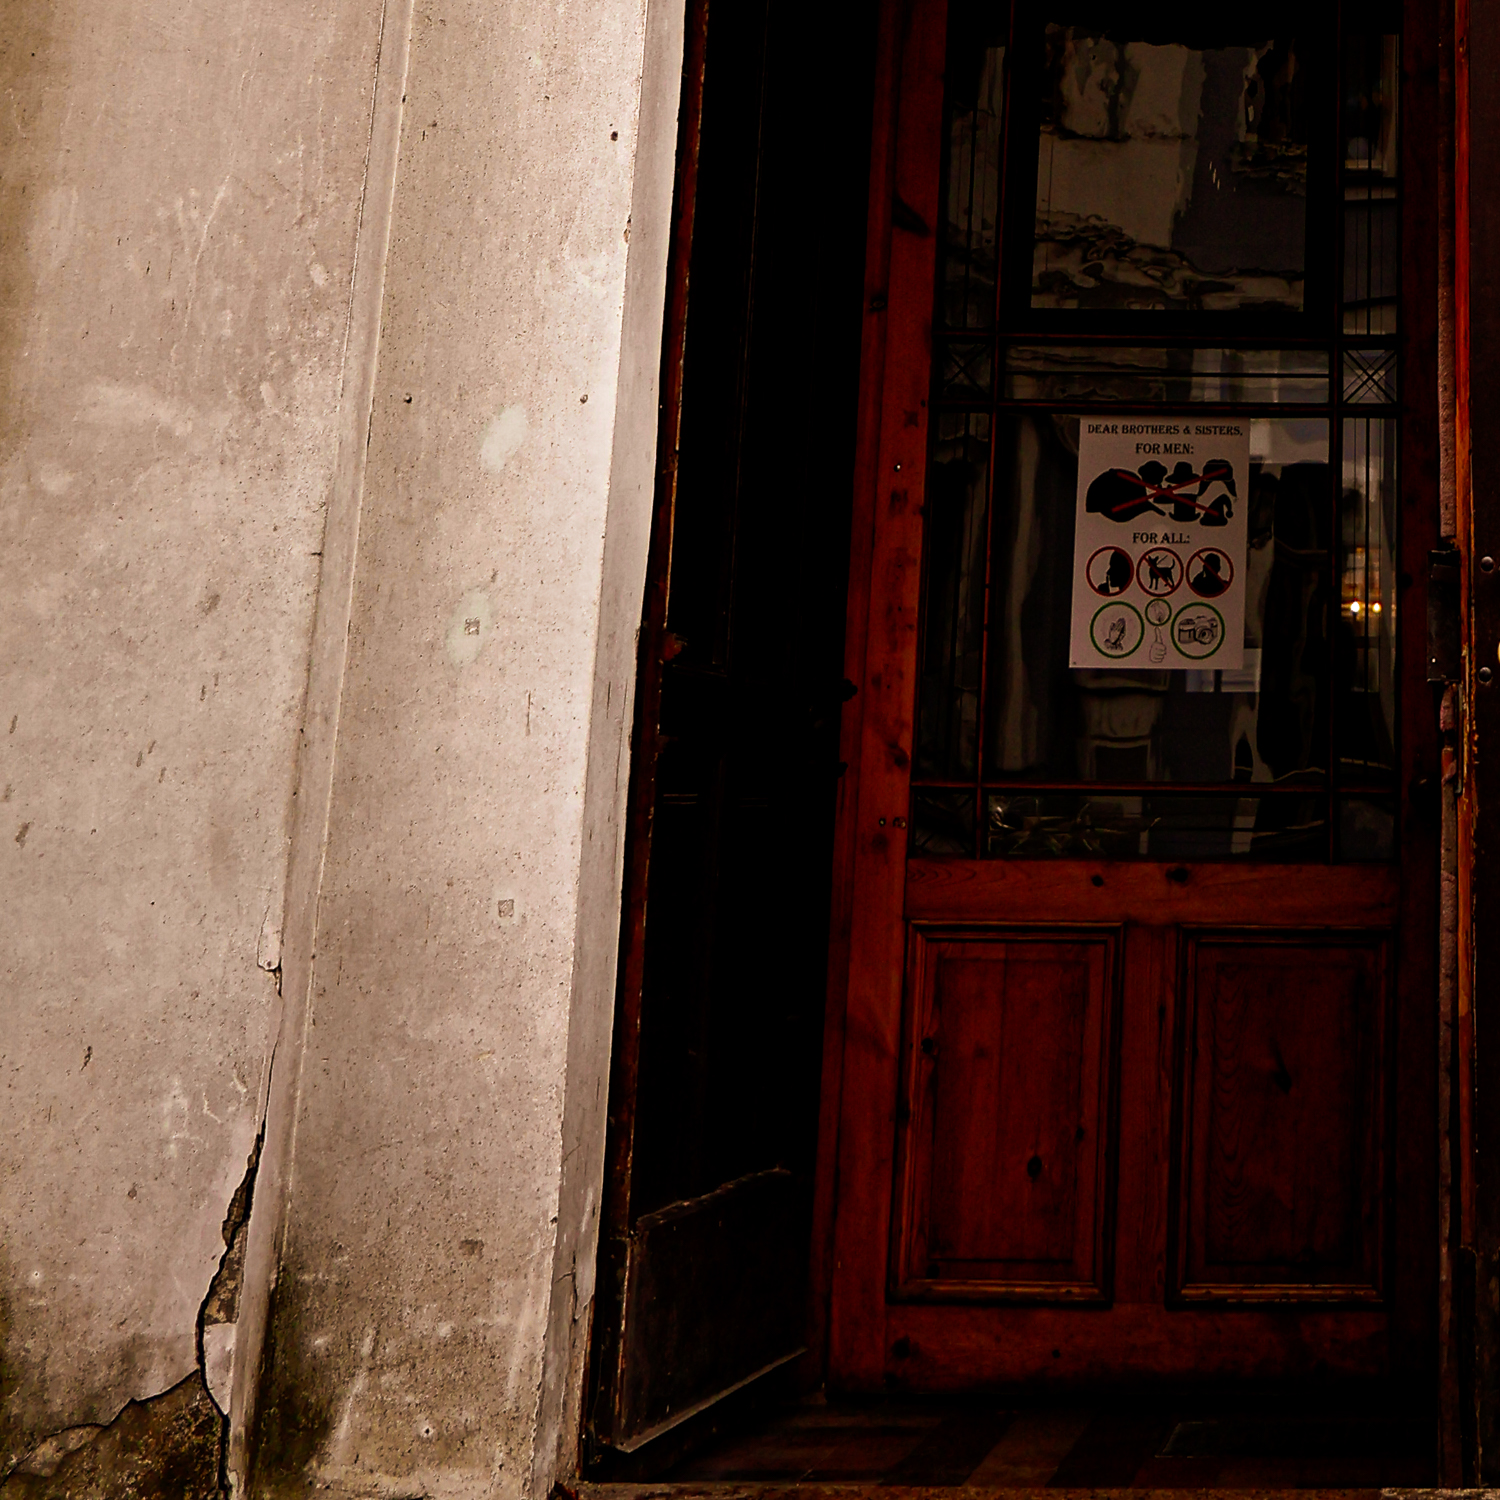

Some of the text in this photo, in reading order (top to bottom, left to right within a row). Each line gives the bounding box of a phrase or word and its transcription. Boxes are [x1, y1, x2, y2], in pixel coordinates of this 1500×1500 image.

[1088, 424, 1118, 434] DEAR
[1122, 425, 1179, 434] BROTHERS
[1183, 426, 1191, 434] &
[1136, 443, 1193, 454] FOR MEN:
[1133, 532, 1190, 544] FOR ALL:
